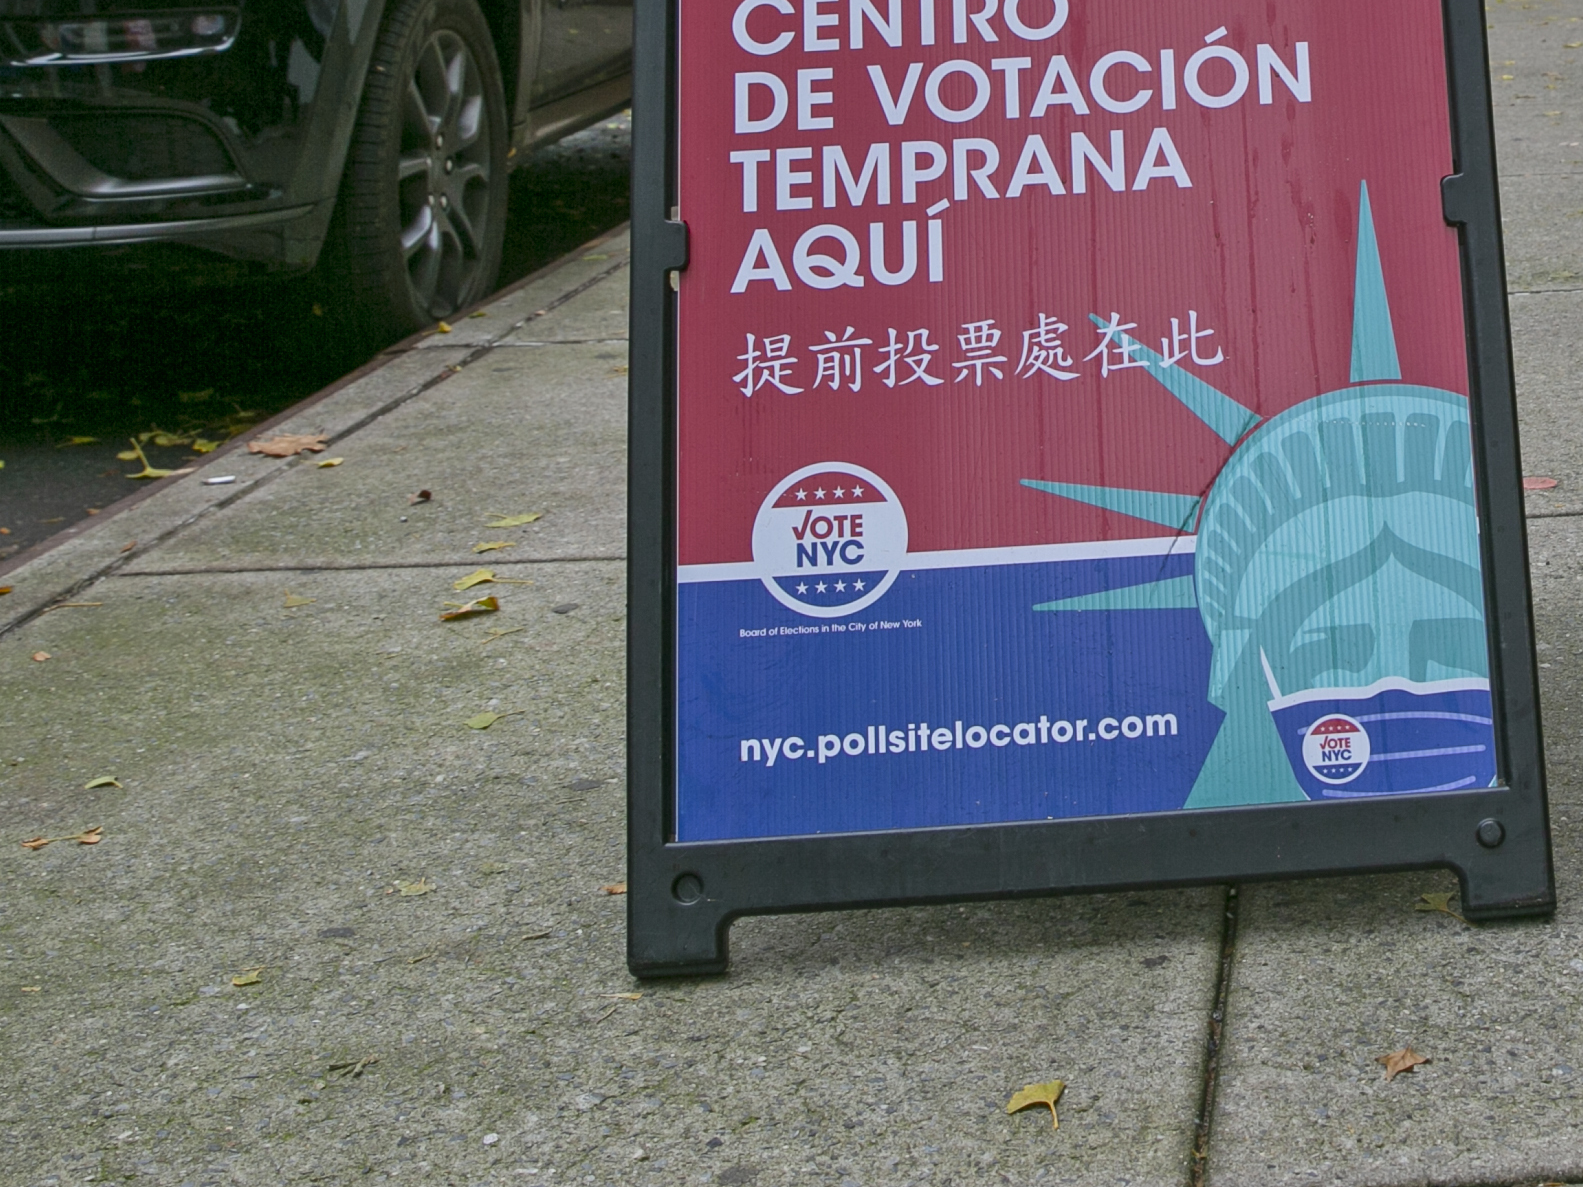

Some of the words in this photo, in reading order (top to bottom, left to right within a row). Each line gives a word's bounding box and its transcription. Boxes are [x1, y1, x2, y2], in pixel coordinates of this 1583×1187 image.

[734, 67, 834, 134] DE
[868, 26, 1313, 126] VOTACIÓN
[730, 127, 1193, 212] TEMPRANA
[730, 199, 951, 294] AQUÍ
[732, 310, 1225, 398] 提前投票處在此
[792, 509, 863, 540] VOTE
[796, 539, 865, 568] NYC
[740, 623, 766, 637] Board
[768, 626, 778, 636] of
[780, 624, 819, 635] Elections
[821, 624, 830, 633] in
[831, 623, 847, 632] the
[848, 621, 866, 633] City
[868, 621, 878, 630] of
[880, 620, 900, 629] New
[902, 619, 922, 628] York
[740, 711, 1179, 767] nyc.pollsitelocator.com
[1319, 735, 1351, 750] VOTE
[1322, 749, 1352, 762] NYC
